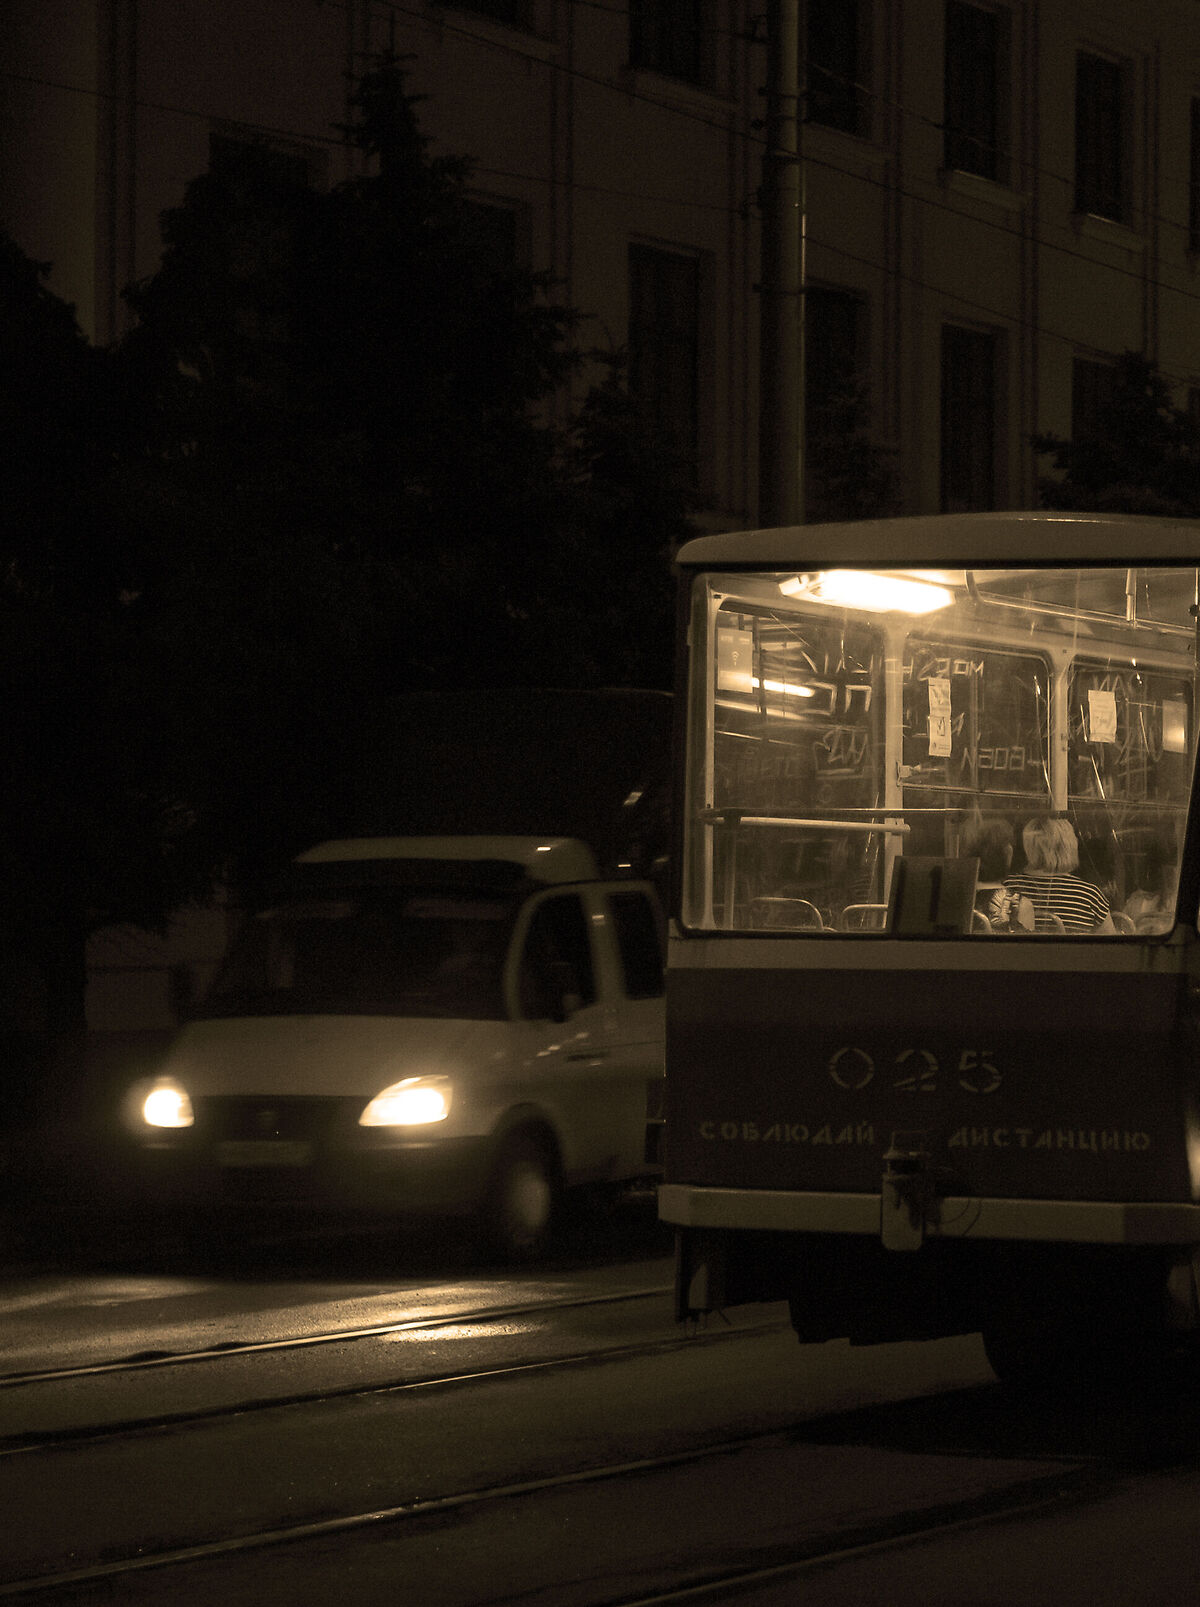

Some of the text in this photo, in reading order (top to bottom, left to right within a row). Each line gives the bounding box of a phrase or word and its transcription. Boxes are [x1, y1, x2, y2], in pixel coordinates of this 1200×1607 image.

[828, 1046, 1002, 1094] 025
[699, 1119, 1151, 1153] СОБЛЮДАЙ ДИСТАНЦИЮ
